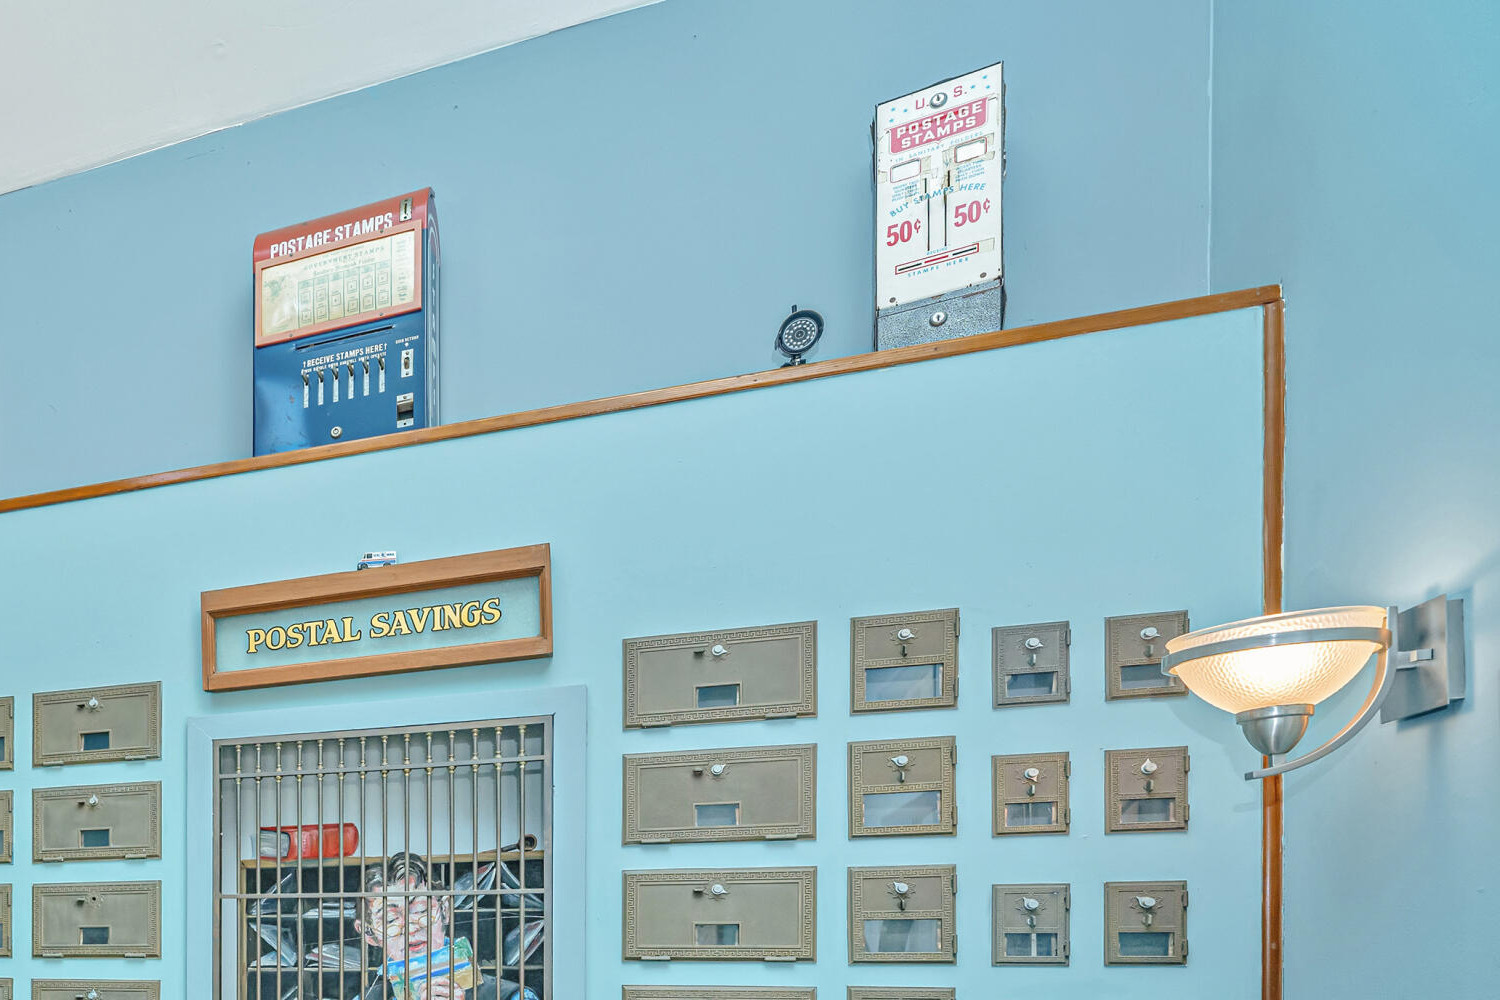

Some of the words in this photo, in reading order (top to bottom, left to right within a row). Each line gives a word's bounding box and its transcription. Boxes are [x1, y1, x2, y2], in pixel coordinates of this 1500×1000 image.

[916, 97, 930, 110] U.
[953, 85, 968, 98] S.
[896, 100, 983, 139] POSTAGE
[901, 116, 976, 149] STAMPS
[889, 201, 909, 217] BUY
[913, 186, 954, 205] STAMPS
[959, 182, 987, 191] HERE
[954, 198, 991, 228] 50¢
[270, 228, 332, 259] POSTAGE
[334, 212, 393, 242] STAMPS
[886, 218, 921, 247] 50¢
[306, 354, 335, 368] RECEIVE
[336, 348, 364, 362] STAMPS
[365, 344, 384, 354] HERE
[246, 616, 361, 654] POSTAL
[368, 598, 502, 638] SAVINGS
